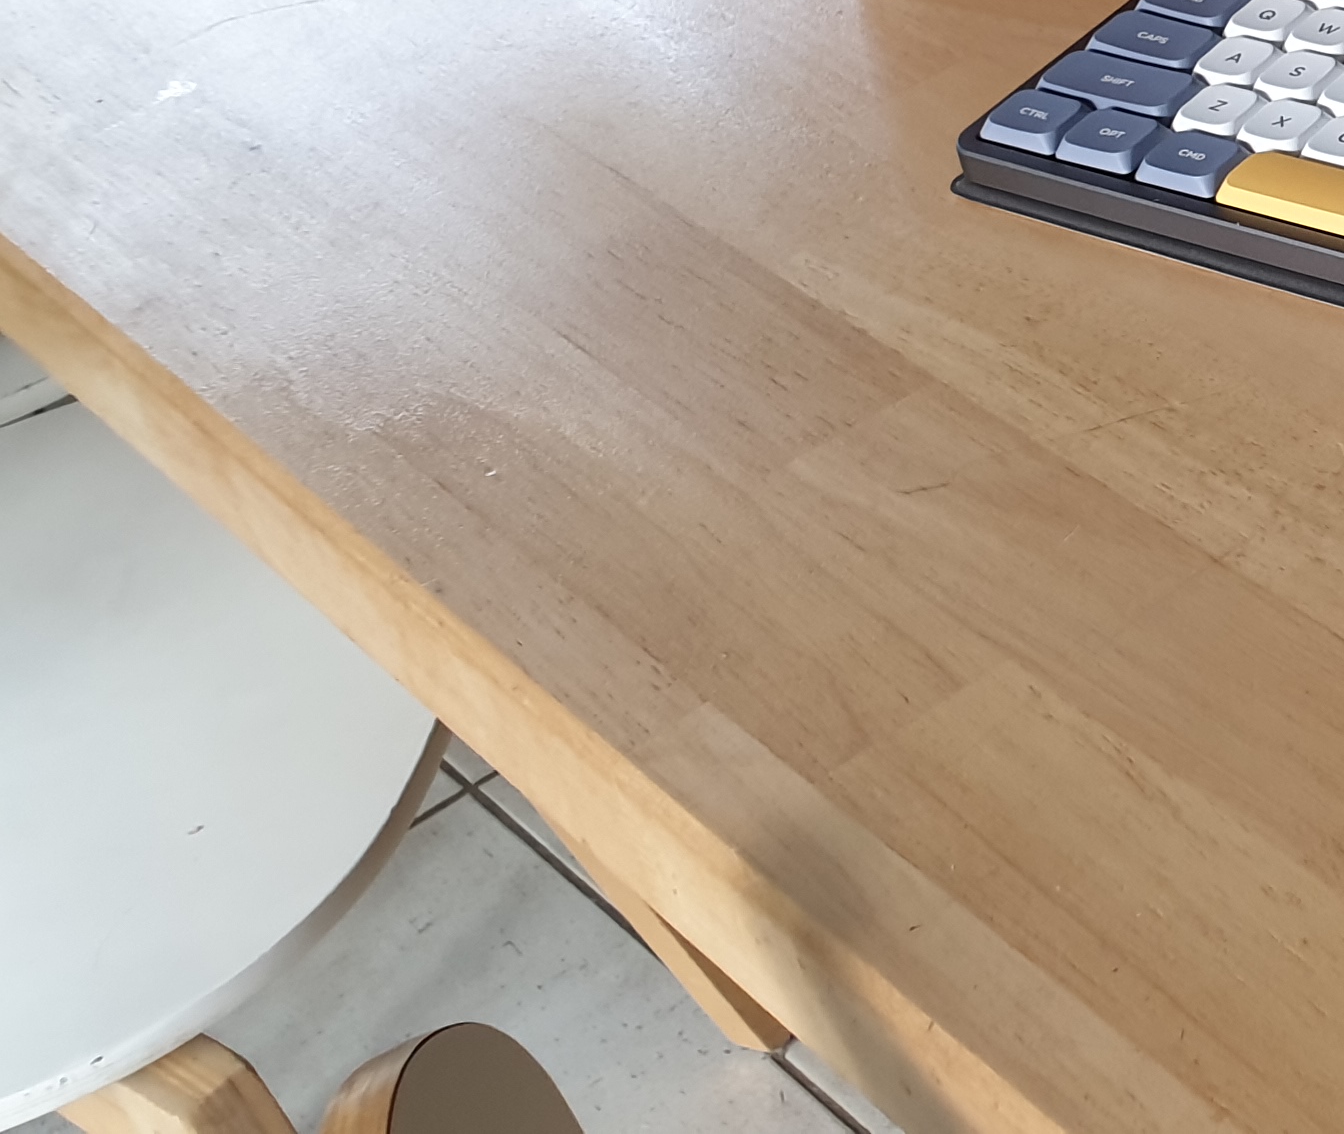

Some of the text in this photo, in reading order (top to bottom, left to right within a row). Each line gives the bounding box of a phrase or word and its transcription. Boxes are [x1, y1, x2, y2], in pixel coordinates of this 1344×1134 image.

[1259, 10, 1276, 20] Q
[1319, 23, 1340, 34] W
[1137, 32, 1169, 44] CAPS
[1225, 53, 1241, 63] A
[1289, 67, 1305, 76] S
[1101, 75, 1135, 87] SHIFT
[1208, 100, 1228, 112] Z
[1020, 107, 1048, 120] CTRL
[1272, 116, 1291, 127] X
[1099, 128, 1126, 138] OPT
[1178, 149, 1206, 160] CMD
